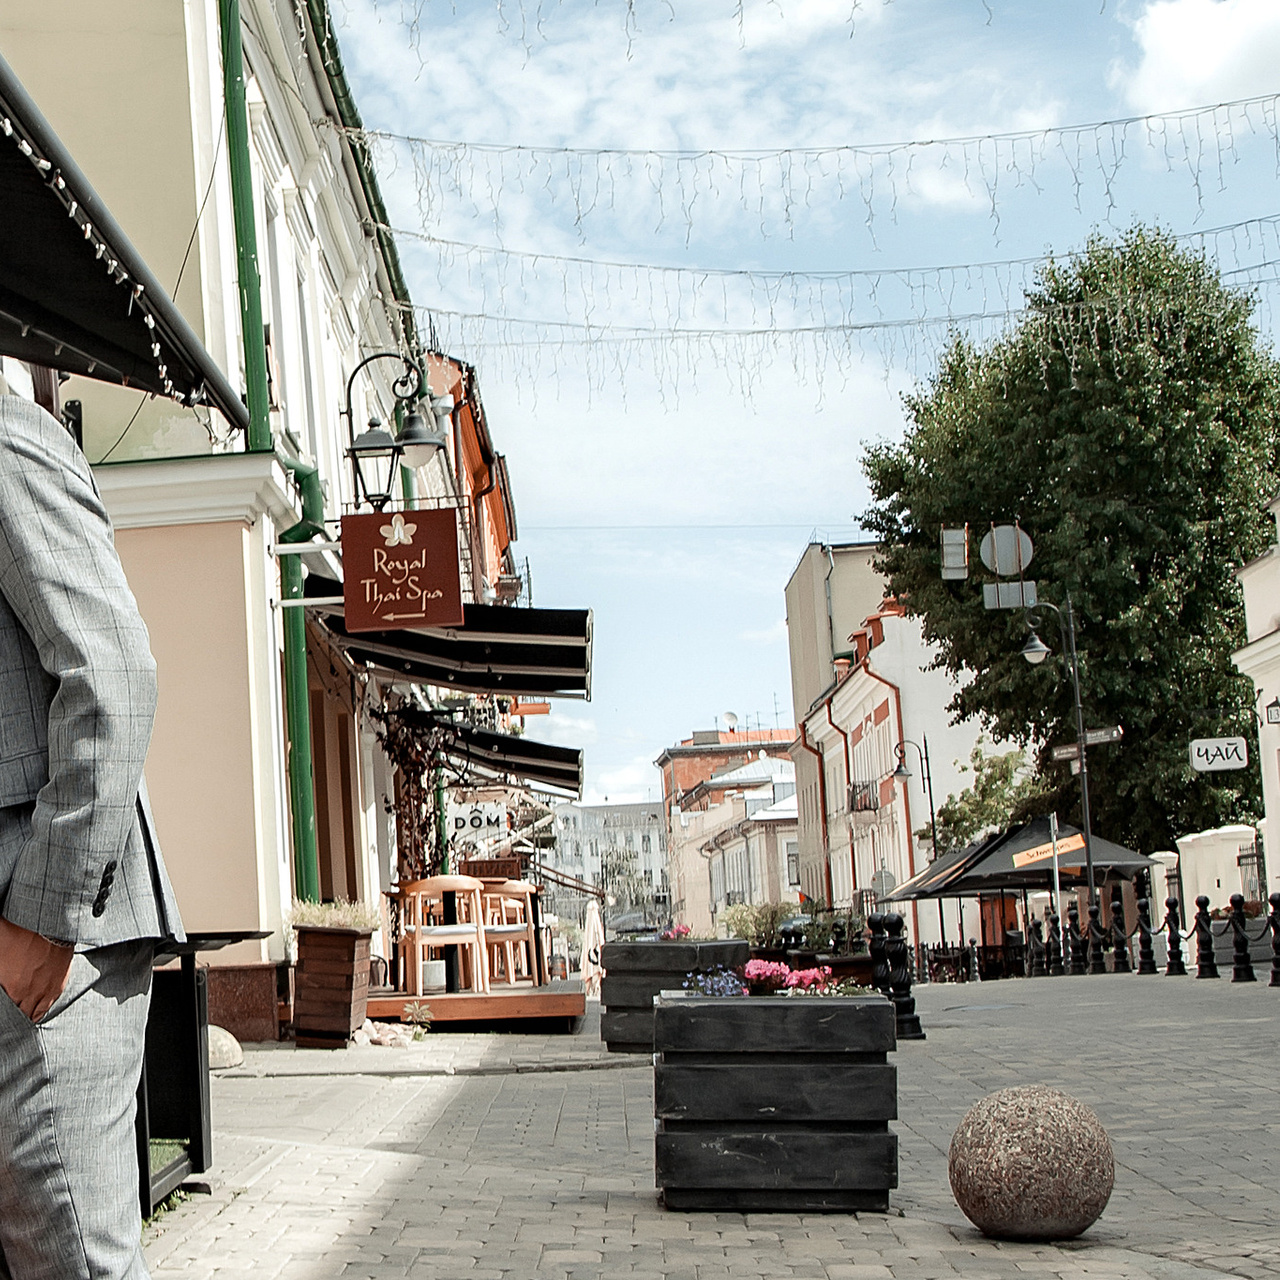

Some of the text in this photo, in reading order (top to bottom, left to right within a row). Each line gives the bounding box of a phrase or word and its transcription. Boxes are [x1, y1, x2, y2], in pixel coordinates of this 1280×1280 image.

[373, 548, 426, 584] Royal
[360, 576, 443, 614] Thai Spa
[1196, 742, 1244, 765] ЧАЙ
[1025, 842, 1071, 859] Schwepes
